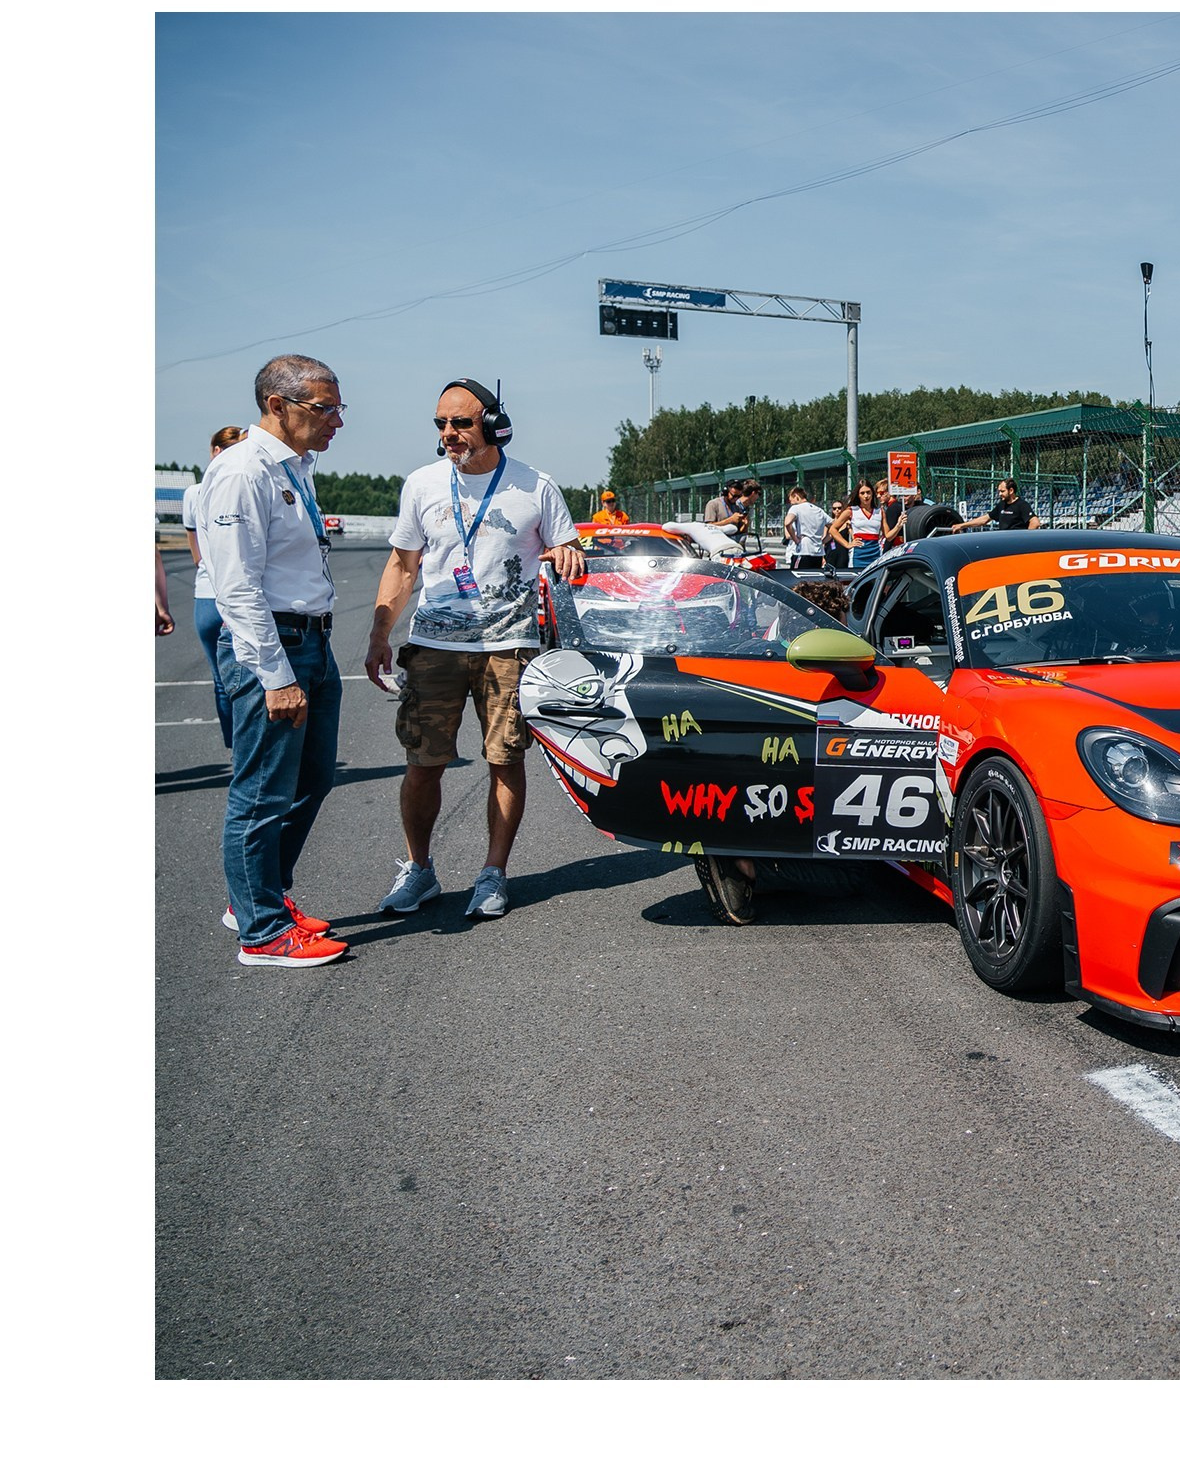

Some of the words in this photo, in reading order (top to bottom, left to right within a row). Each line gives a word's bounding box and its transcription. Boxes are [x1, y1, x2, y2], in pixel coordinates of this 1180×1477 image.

[666, 292, 691, 300] RACING
[894, 467, 912, 480] 74
[965, 579, 1065, 624] 46
[970, 610, 1074, 641] С.ГОРБУНОВА
[661, 709, 702, 742] HA
[761, 736, 800, 765] HA
[660, 780, 738, 823] WHY
[743, 784, 788, 823] SO
[832, 774, 935, 828] 46
[841, 836, 881, 851] SMP
